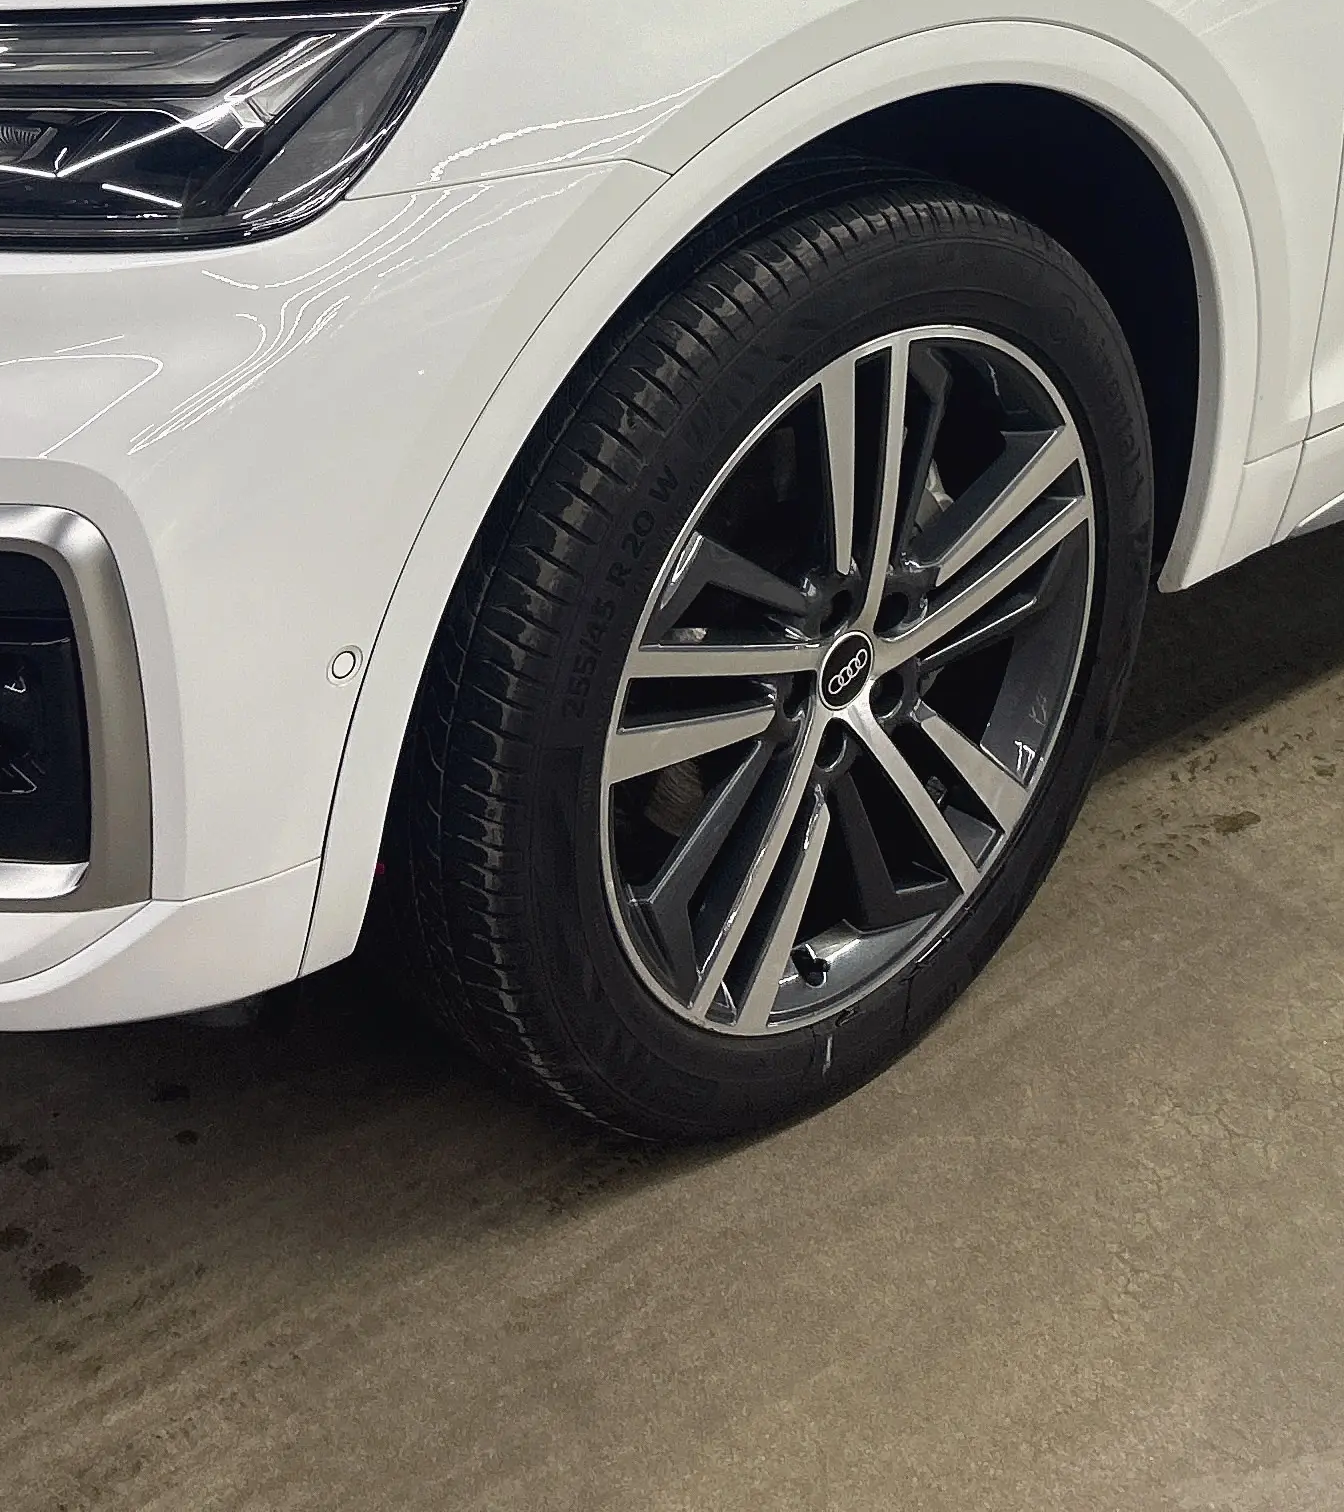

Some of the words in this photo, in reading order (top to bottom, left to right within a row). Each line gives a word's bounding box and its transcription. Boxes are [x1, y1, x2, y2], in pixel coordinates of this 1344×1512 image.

[647, 461, 681, 507] W
[619, 504, 658, 559] 20
[607, 559, 634, 589] R
